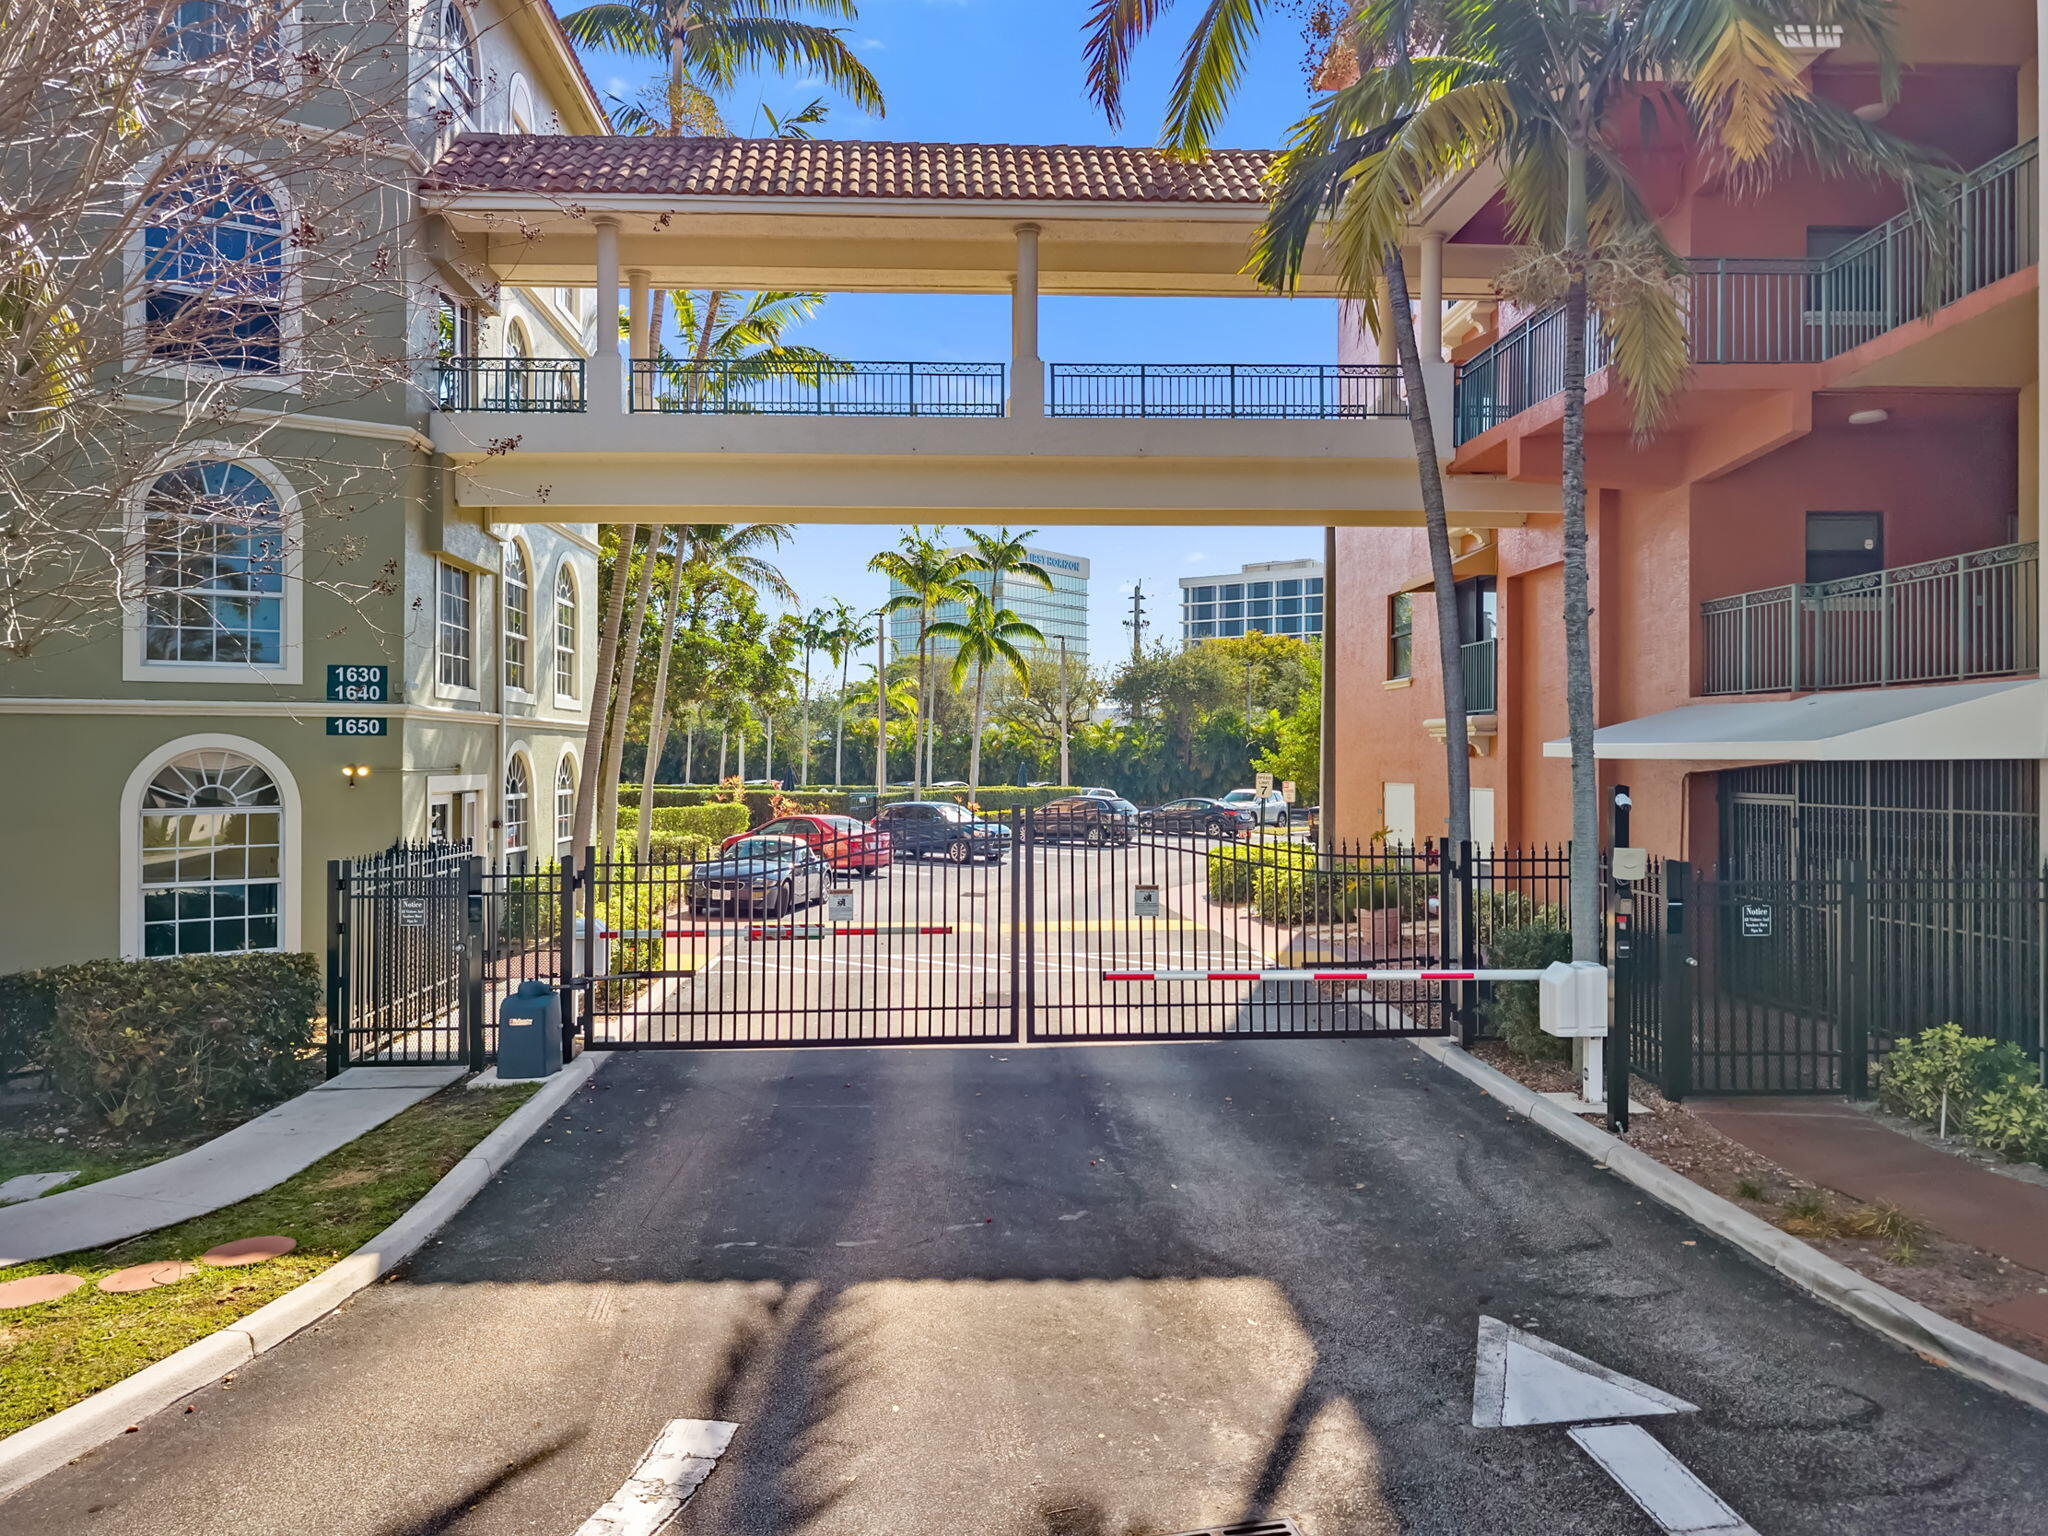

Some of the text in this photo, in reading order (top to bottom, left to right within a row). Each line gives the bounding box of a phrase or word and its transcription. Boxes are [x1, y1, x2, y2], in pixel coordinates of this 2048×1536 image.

[1046, 557, 1080, 572] HORIZON
[335, 667, 380, 682] 1630
[335, 685, 380, 700] 1640
[334, 719, 380, 734] 1650
[1260, 786, 1268, 795] 7
[1746, 907, 1768, 915] Notice
